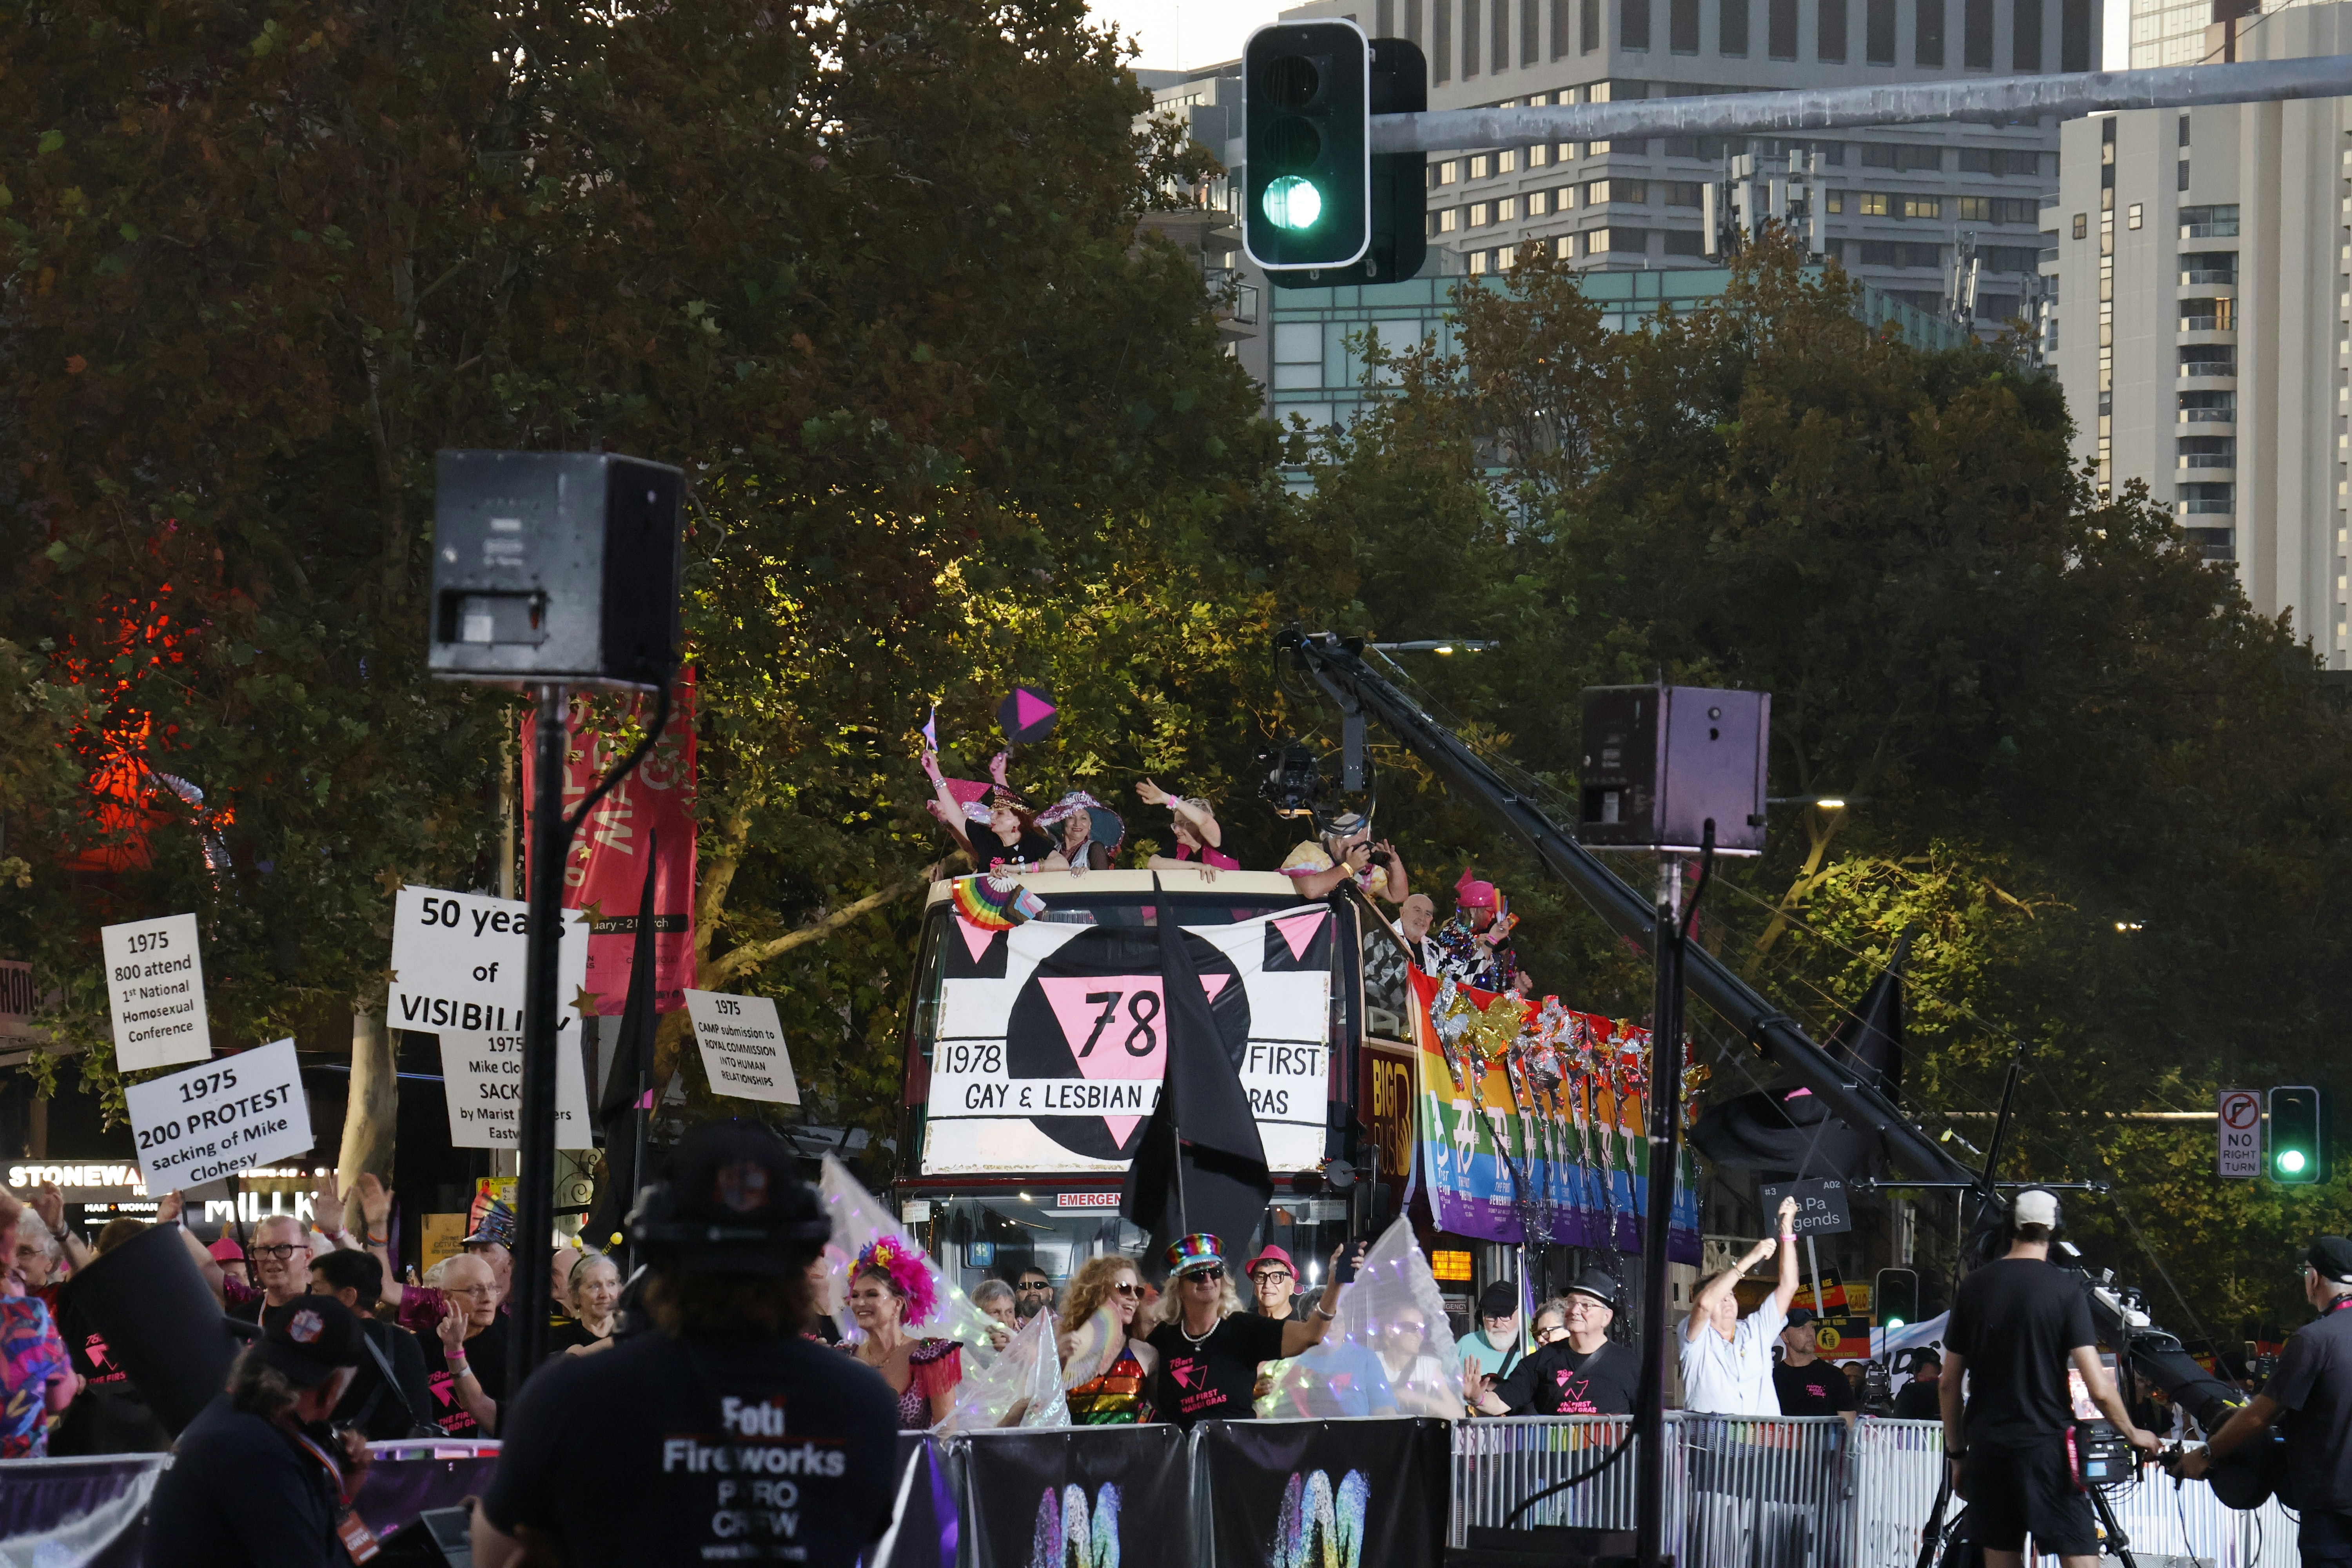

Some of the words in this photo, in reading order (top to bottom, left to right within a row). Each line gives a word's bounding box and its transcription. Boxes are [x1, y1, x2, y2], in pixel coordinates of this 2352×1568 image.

[421, 897, 461, 927] 50
[627, 919, 633, 928] 2
[128, 931, 169, 954] 1975
[115, 964, 141, 981] 800
[144, 954, 192, 977] attend
[473, 962, 499, 982] of
[122, 988, 136, 1002] 1st
[140, 980, 189, 999] National
[122, 999, 194, 1024] Homosexual
[400, 994, 571, 1031] VISIBILI
[715, 999, 740, 1015] 1975
[128, 1022, 194, 1043] Conference
[699, 1022, 719, 1034] CAMP
[721, 1025, 764, 1039] submission
[766, 1030, 775, 1040] to
[488, 1037, 524, 1052] 1975
[704, 1039, 726, 1051] ROYAL
[727, 1042, 776, 1056] COMMISSION
[469, 1060, 498, 1073] Mike
[719, 1056, 736, 1068] INTO
[737, 1059, 766, 1071] HUMAN
[946, 1045, 1001, 1074] 1978
[1249, 1046, 1321, 1076] FIRST
[179, 1069, 237, 1103] 1975
[721, 1070, 773, 1087] RELATIONSHIPS
[479, 1083, 521, 1100] SACK
[1373, 1059, 1394, 1118] BIG
[965, 1084, 1009, 1109] GAY
[1019, 1085, 1032, 1109] &
[1045, 1084, 1142, 1109] LESBIAN
[1250, 1089, 1289, 1114] RAS
[138, 1121, 181, 1150] 200
[187, 1083, 290, 1134] PROTEST
[460, 1107, 474, 1122] by
[477, 1108, 515, 1120] Marist
[152, 1143, 217, 1171] sacking
[221, 1131, 238, 1149] of
[243, 1119, 288, 1142] Mike
[2228, 1134, 2252, 1146] NO
[2223, 1150, 2256, 1159] RIGHT
[190, 1152, 257, 1182] Clohesy
[2225, 1163, 2256, 1171] TURN
[1824, 1181, 1840, 1189] A02
[85, 1203, 107, 1212] MAN
[118, 1203, 158, 1212] WOMAN
[1059, 1194, 1122, 1206] EMERGEN
[1806, 1198, 1826, 1211] Pa
[106, 1371, 127, 1383] FIRS
[428, 1371, 451, 1384] 78er
[1180, 1395, 1194, 1405] THE
[1196, 1388, 1218, 1401] FIRST
[1206, 1394, 1227, 1406] GRAS
[438, 1415, 454, 1425] THE
[455, 1411, 469, 1421] FIR
